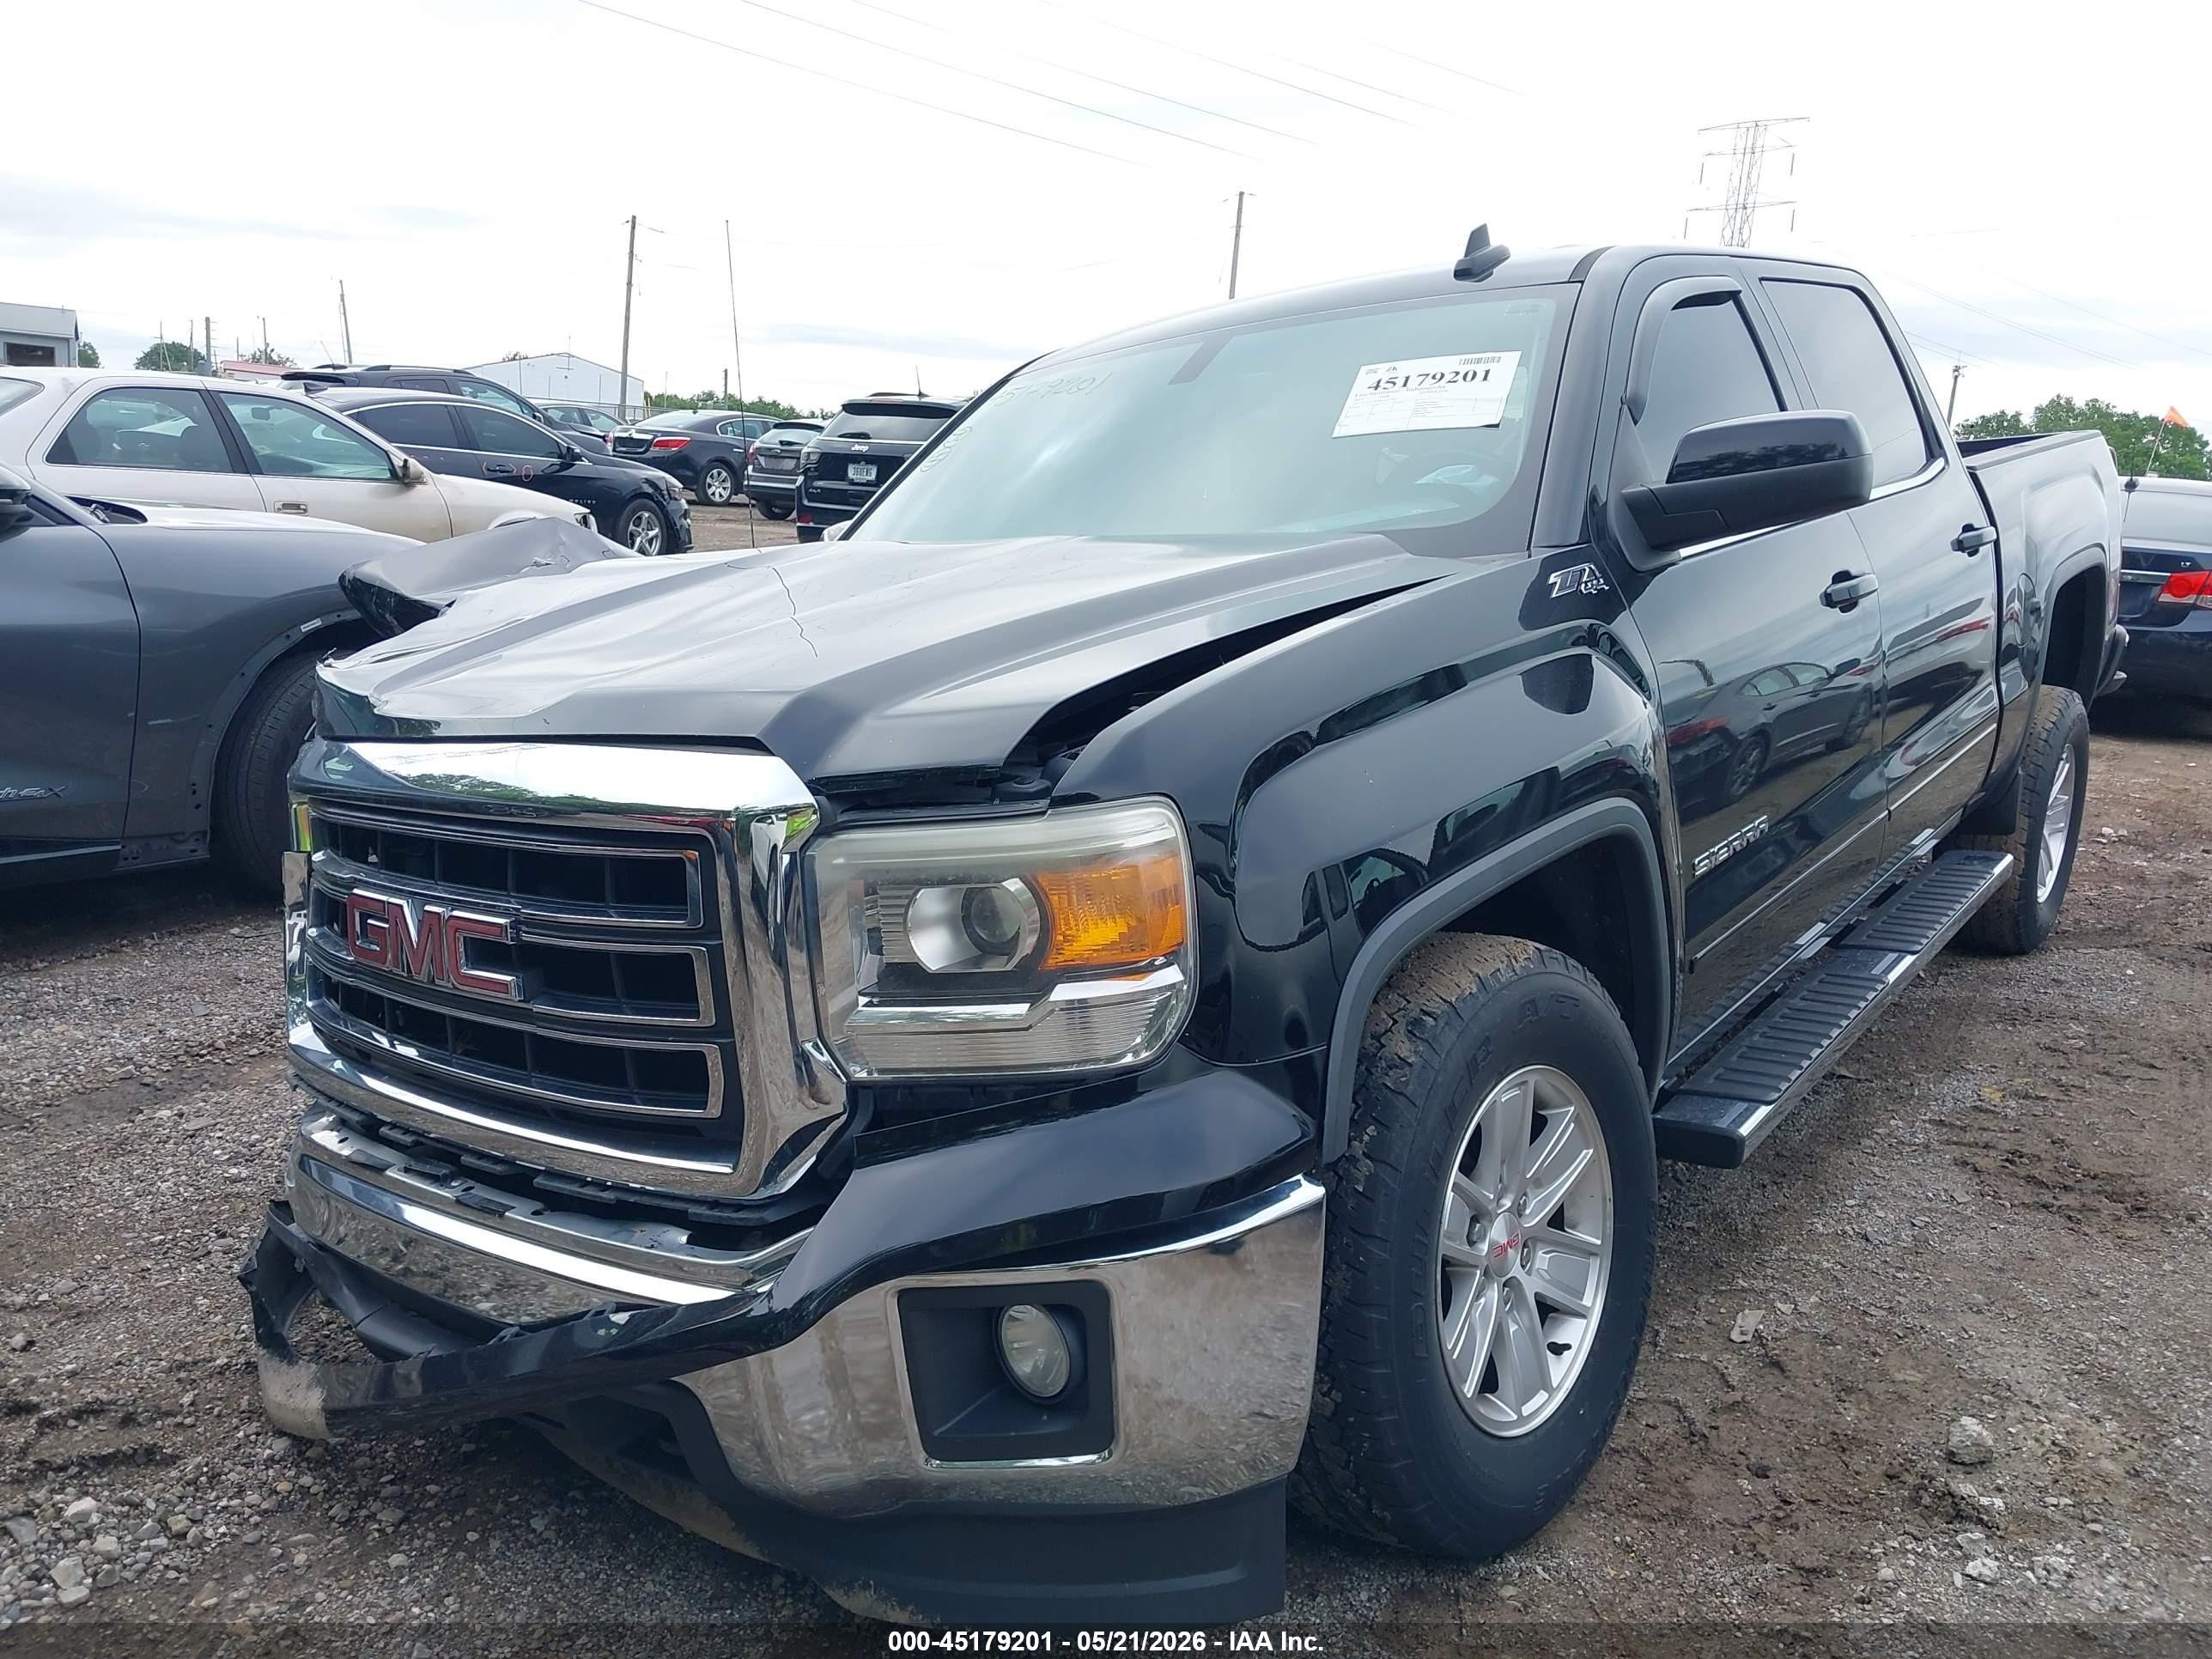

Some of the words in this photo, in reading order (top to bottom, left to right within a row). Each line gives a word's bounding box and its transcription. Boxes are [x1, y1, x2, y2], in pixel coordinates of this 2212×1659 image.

[1367, 368, 1491, 391] 45179201
[851, 444, 869, 453] Jeep
[1692, 815, 1769, 878] SIERRA
[346, 888, 525, 1002] GMC
[1492, 1231, 1520, 1258] GMC
